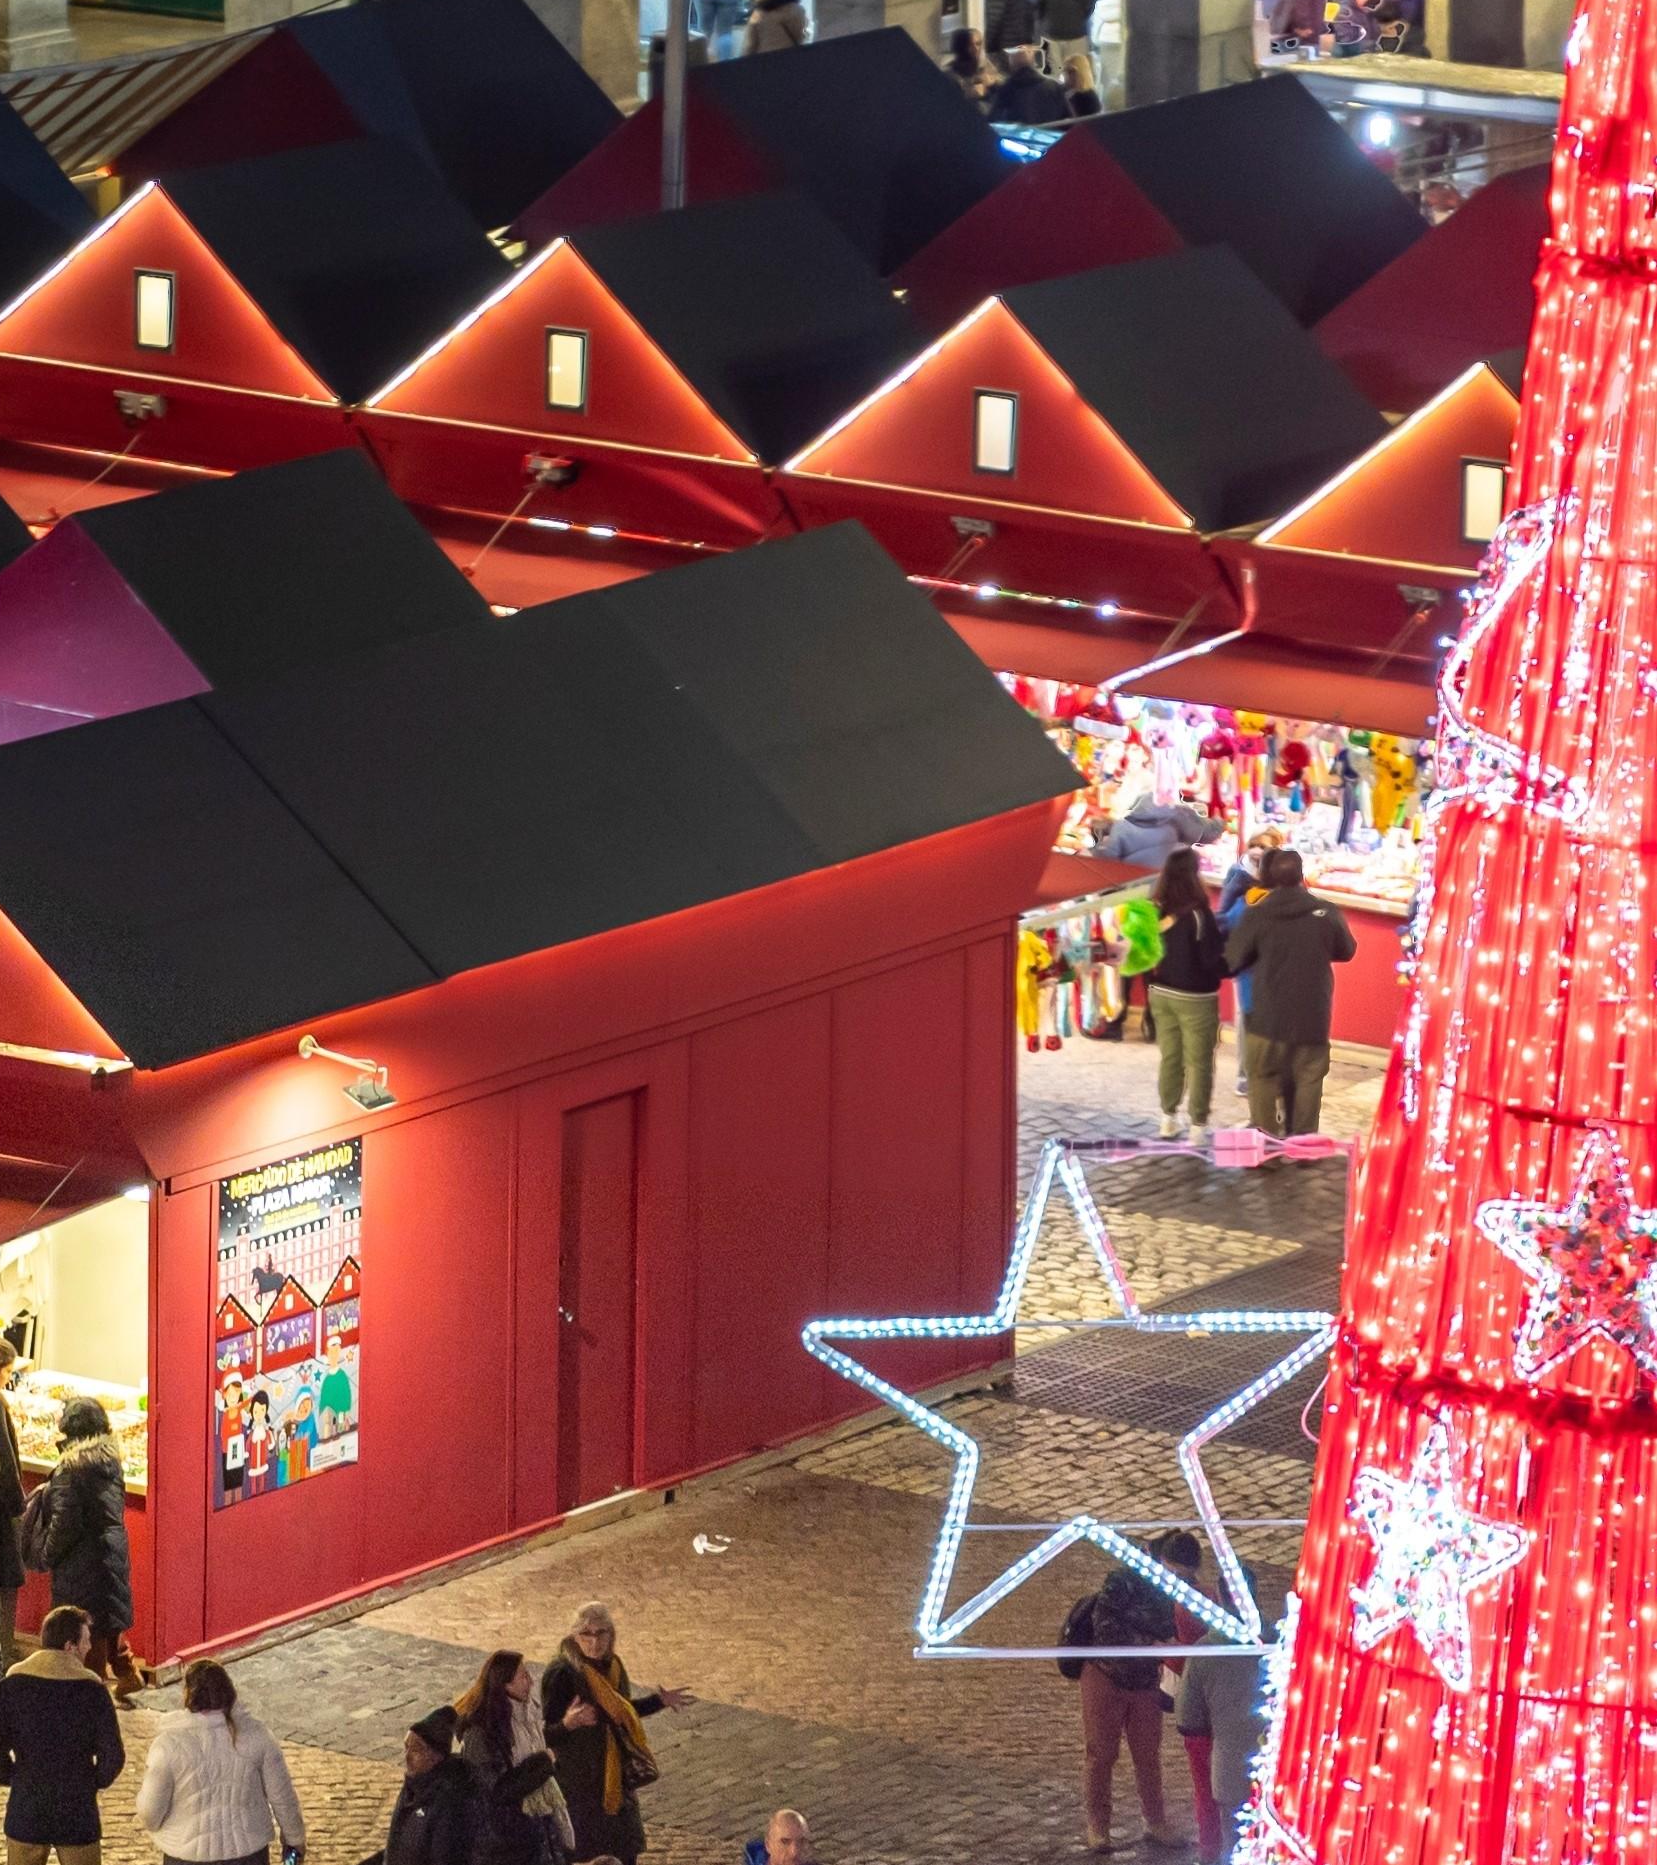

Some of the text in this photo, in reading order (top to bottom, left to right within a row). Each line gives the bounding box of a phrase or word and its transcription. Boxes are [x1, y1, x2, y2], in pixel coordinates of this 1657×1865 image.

[229, 1145, 353, 1200] MERCADO DE NAVIDAD
